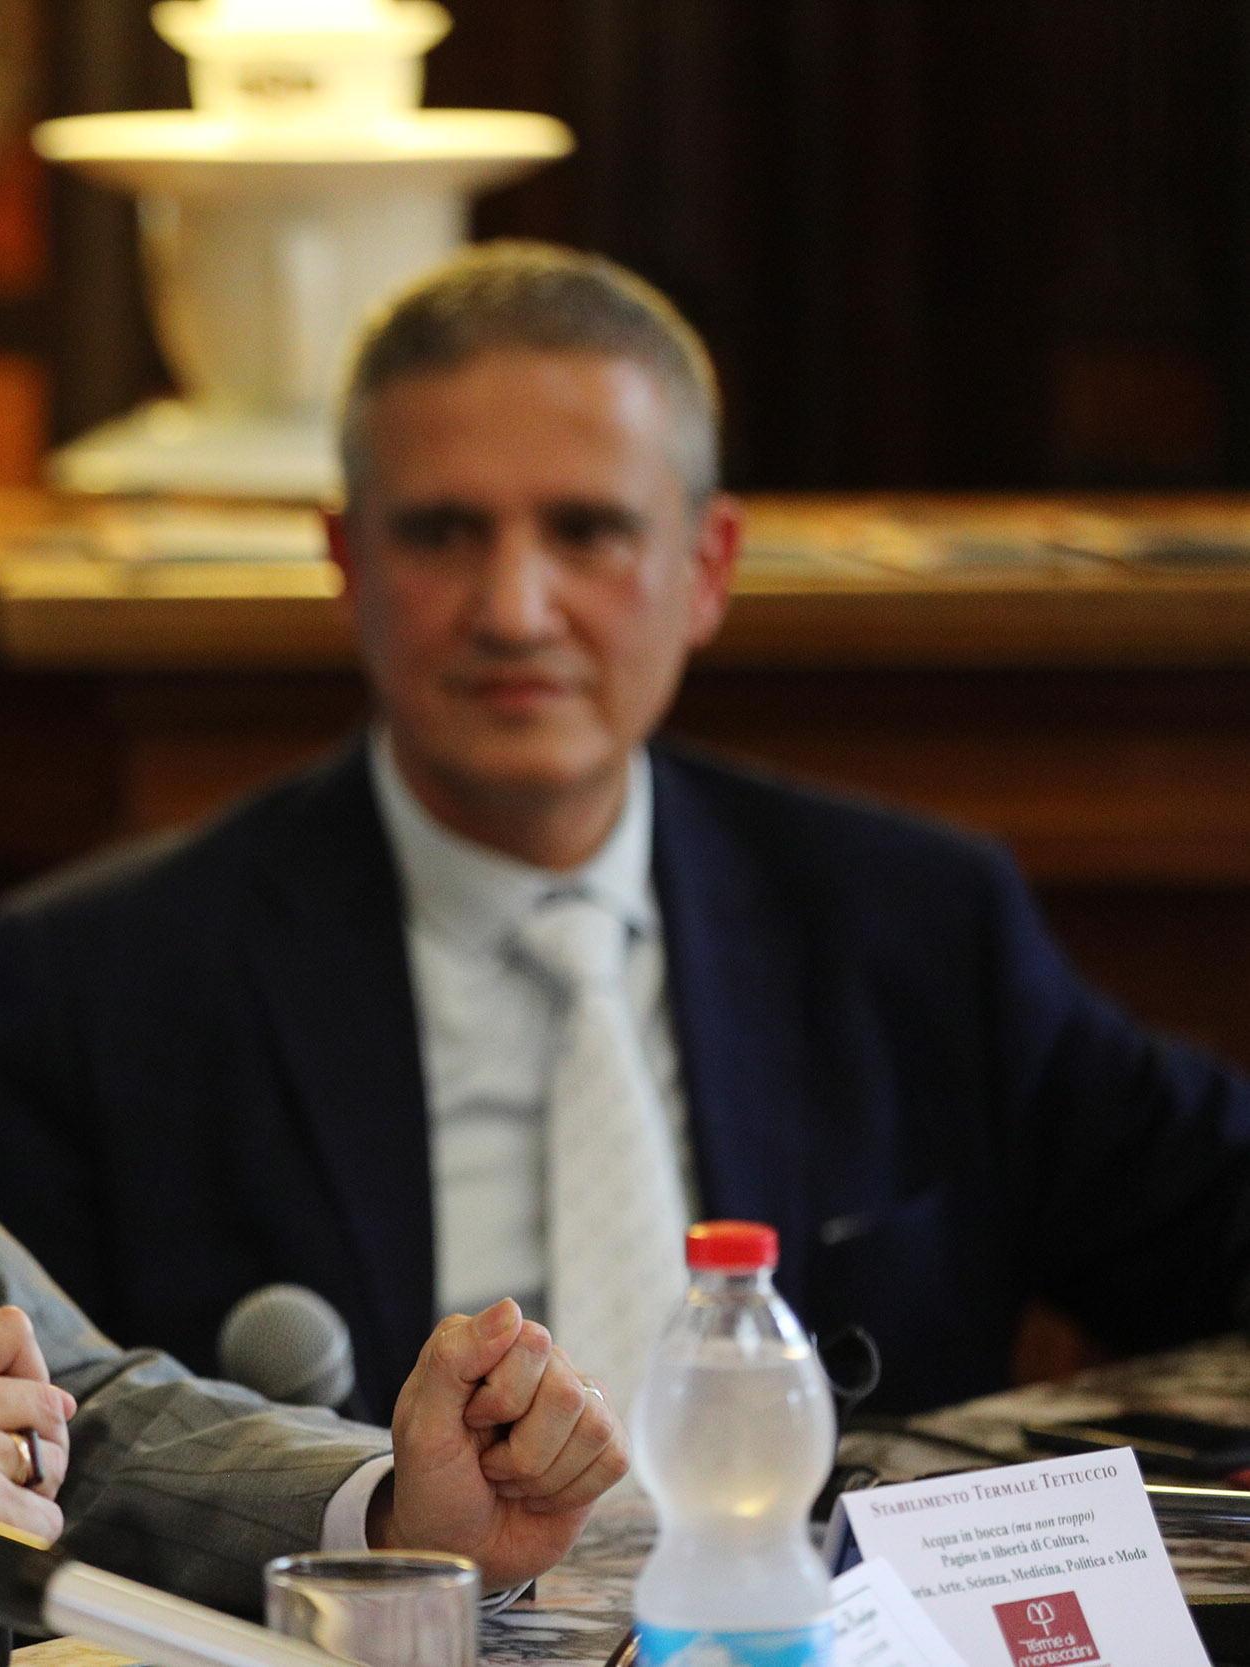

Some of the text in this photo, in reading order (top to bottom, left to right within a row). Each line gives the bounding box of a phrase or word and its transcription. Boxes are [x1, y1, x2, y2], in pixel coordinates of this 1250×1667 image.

[870, 1465, 1117, 1517] STABILIMENTO TERMALE TETTUCCIO
[921, 1509, 1095, 1549] Acqua in bocca (ma non troppo)
[941, 1532, 1090, 1567] Pagine in libertà di Cultura,
[938, 1582, 966, 1594] Arte,
[965, 1573, 1012, 1590] Scienza,
[1011, 1562, 1066, 1581] Medicina,
[1066, 1554, 1106, 1572] Politica
[1107, 1554, 1115, 1565] e
[1115, 1546, 1148, 1562] Moda
